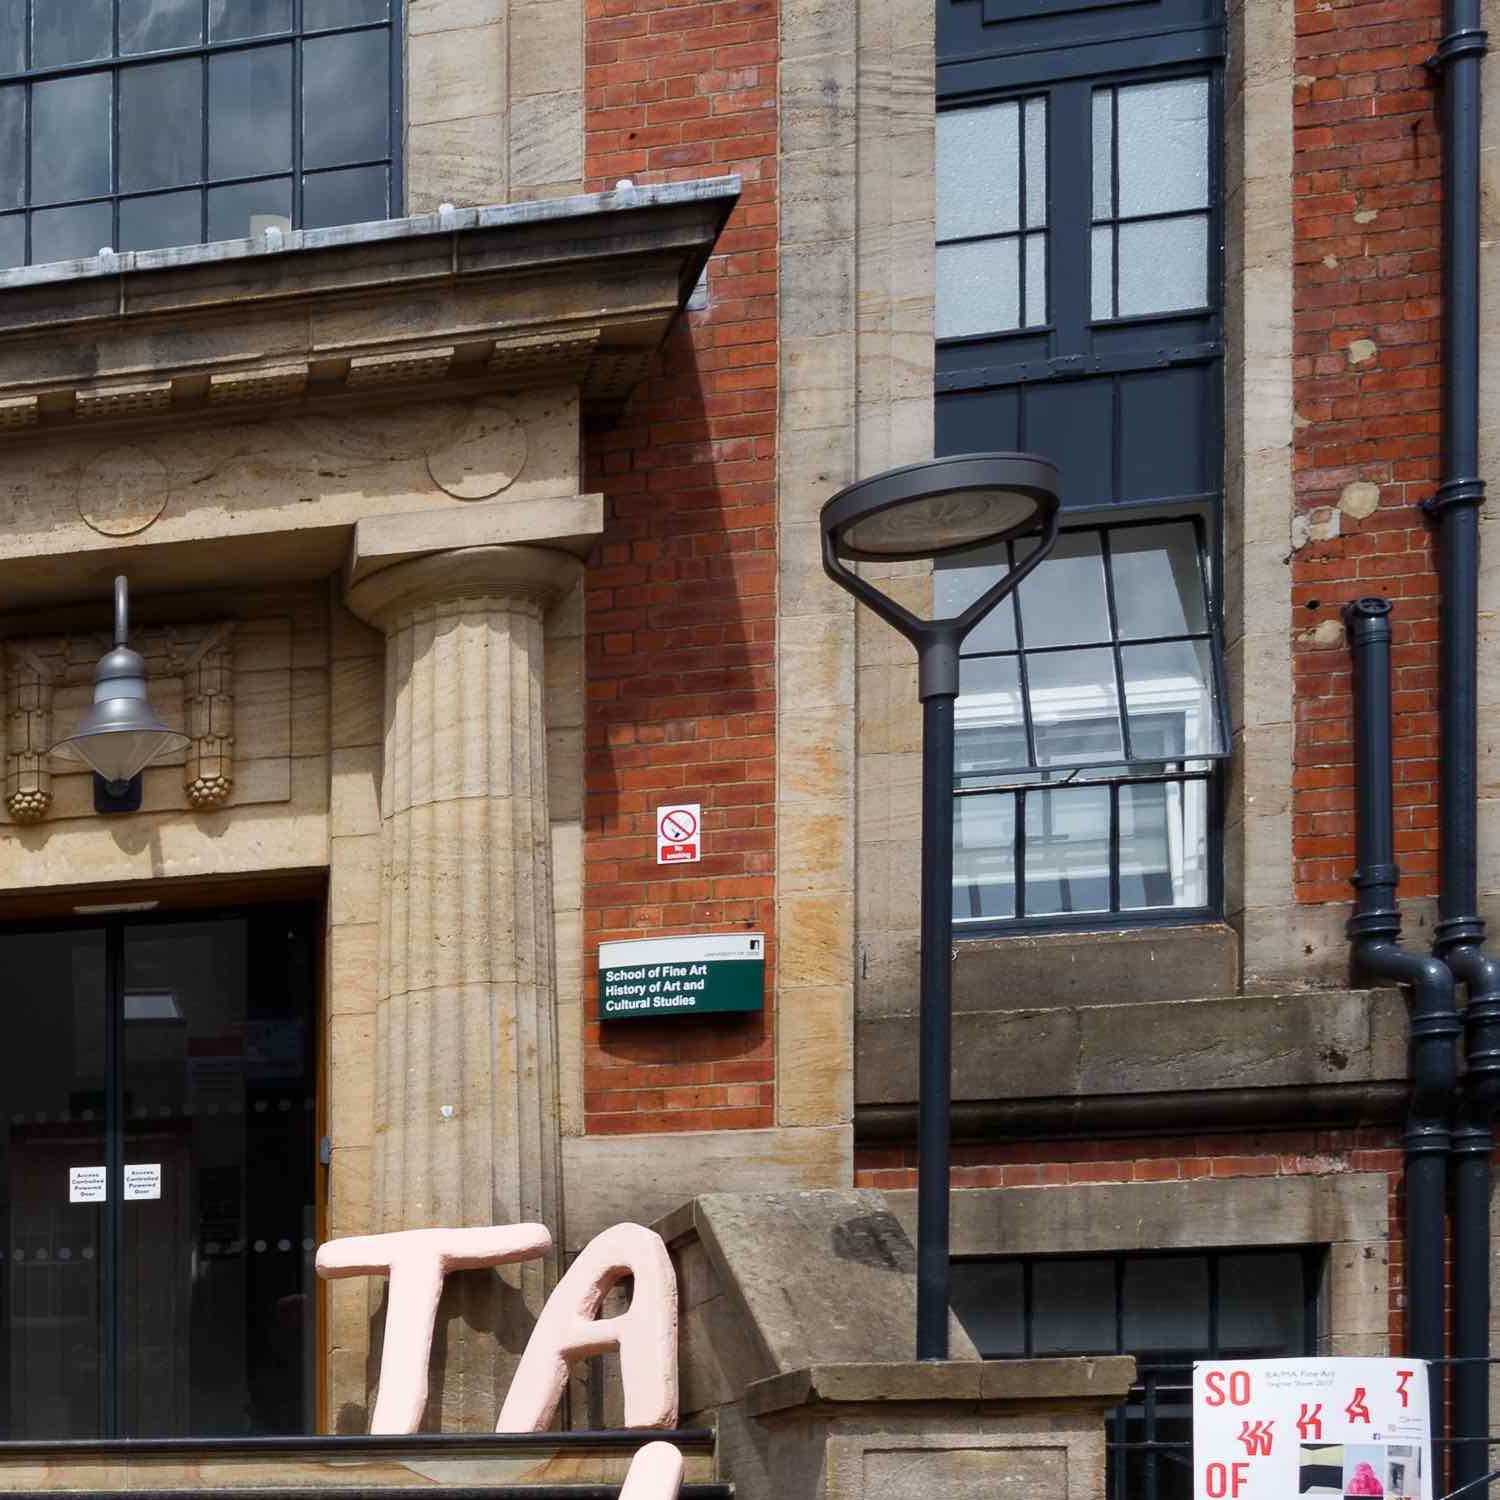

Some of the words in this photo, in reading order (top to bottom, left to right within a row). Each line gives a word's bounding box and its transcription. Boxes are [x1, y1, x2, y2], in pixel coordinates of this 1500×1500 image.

[605, 968, 645, 982] School
[648, 966, 660, 978] of
[662, 966, 687, 977] Fine
[689, 964, 708, 976] Art
[605, 983, 646, 997] History
[649, 981, 662, 993] of
[663, 980, 681, 992] Art
[683, 979, 705, 990] and
[605, 997, 650, 1011] Cultural
[653, 995, 696, 1008] Studies
[1205, 1370, 1252, 1406] SO
[1205, 1462, 1250, 1498] OF
